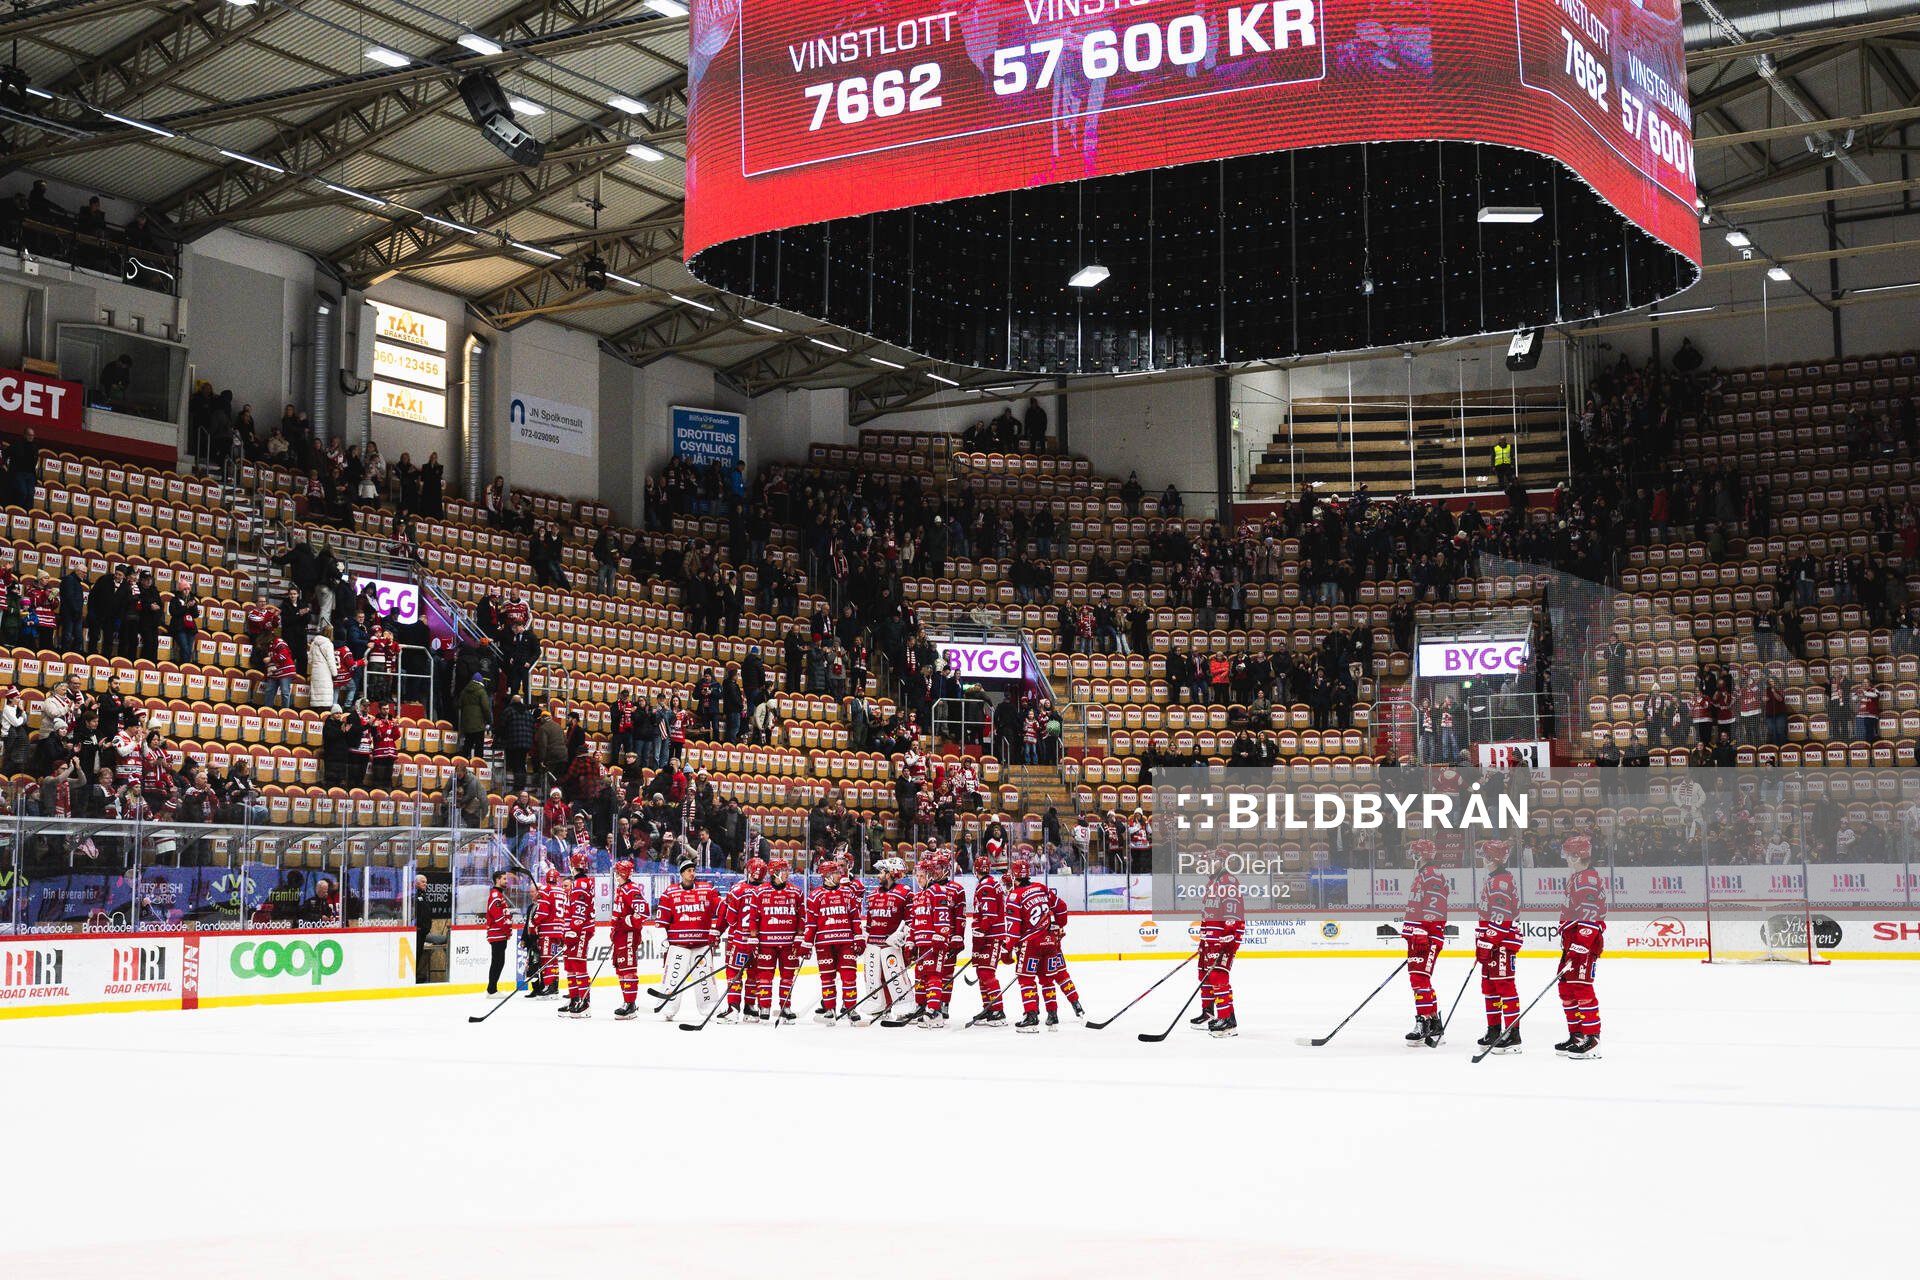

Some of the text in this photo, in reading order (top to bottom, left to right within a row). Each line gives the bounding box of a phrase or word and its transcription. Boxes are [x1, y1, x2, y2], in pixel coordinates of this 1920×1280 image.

[788, 12, 955, 72] VINSTLOTT
[993, 0, 1317, 96] 57 600 KR
[1561, 26, 1608, 113] 7662
[804, 62, 942, 132] 7662
[1621, 86, 1644, 140] 57
[1648, 110, 1686, 174] 600
[388, 316, 424, 338] TAXI
[384, 330, 428, 346] DRAKSTADEN
[386, 392, 423, 414] TAXI
[677, 427, 736, 444] IDROTTENS
[680, 440, 734, 455] OSYNLIGA
[950, 649, 1020, 673] BYGG
[1445, 647, 1522, 671] BYGG
[575, 906, 586, 915] 32
[634, 903, 645, 913] 38
[675, 901, 705, 914] TIMRÅ
[764, 903, 796, 915] TIMRÅ
[1582, 909, 1597, 922] 72
[1256, 927, 1296, 935] OMÖJLIGA
[1770, 933, 1836, 947] Mästren
[456, 946, 470, 954] NP3
[230, 939, 343, 985] coop
[29, 987, 70, 997] RENTAL
[104, 982, 172, 994] ROAD RENTAL
